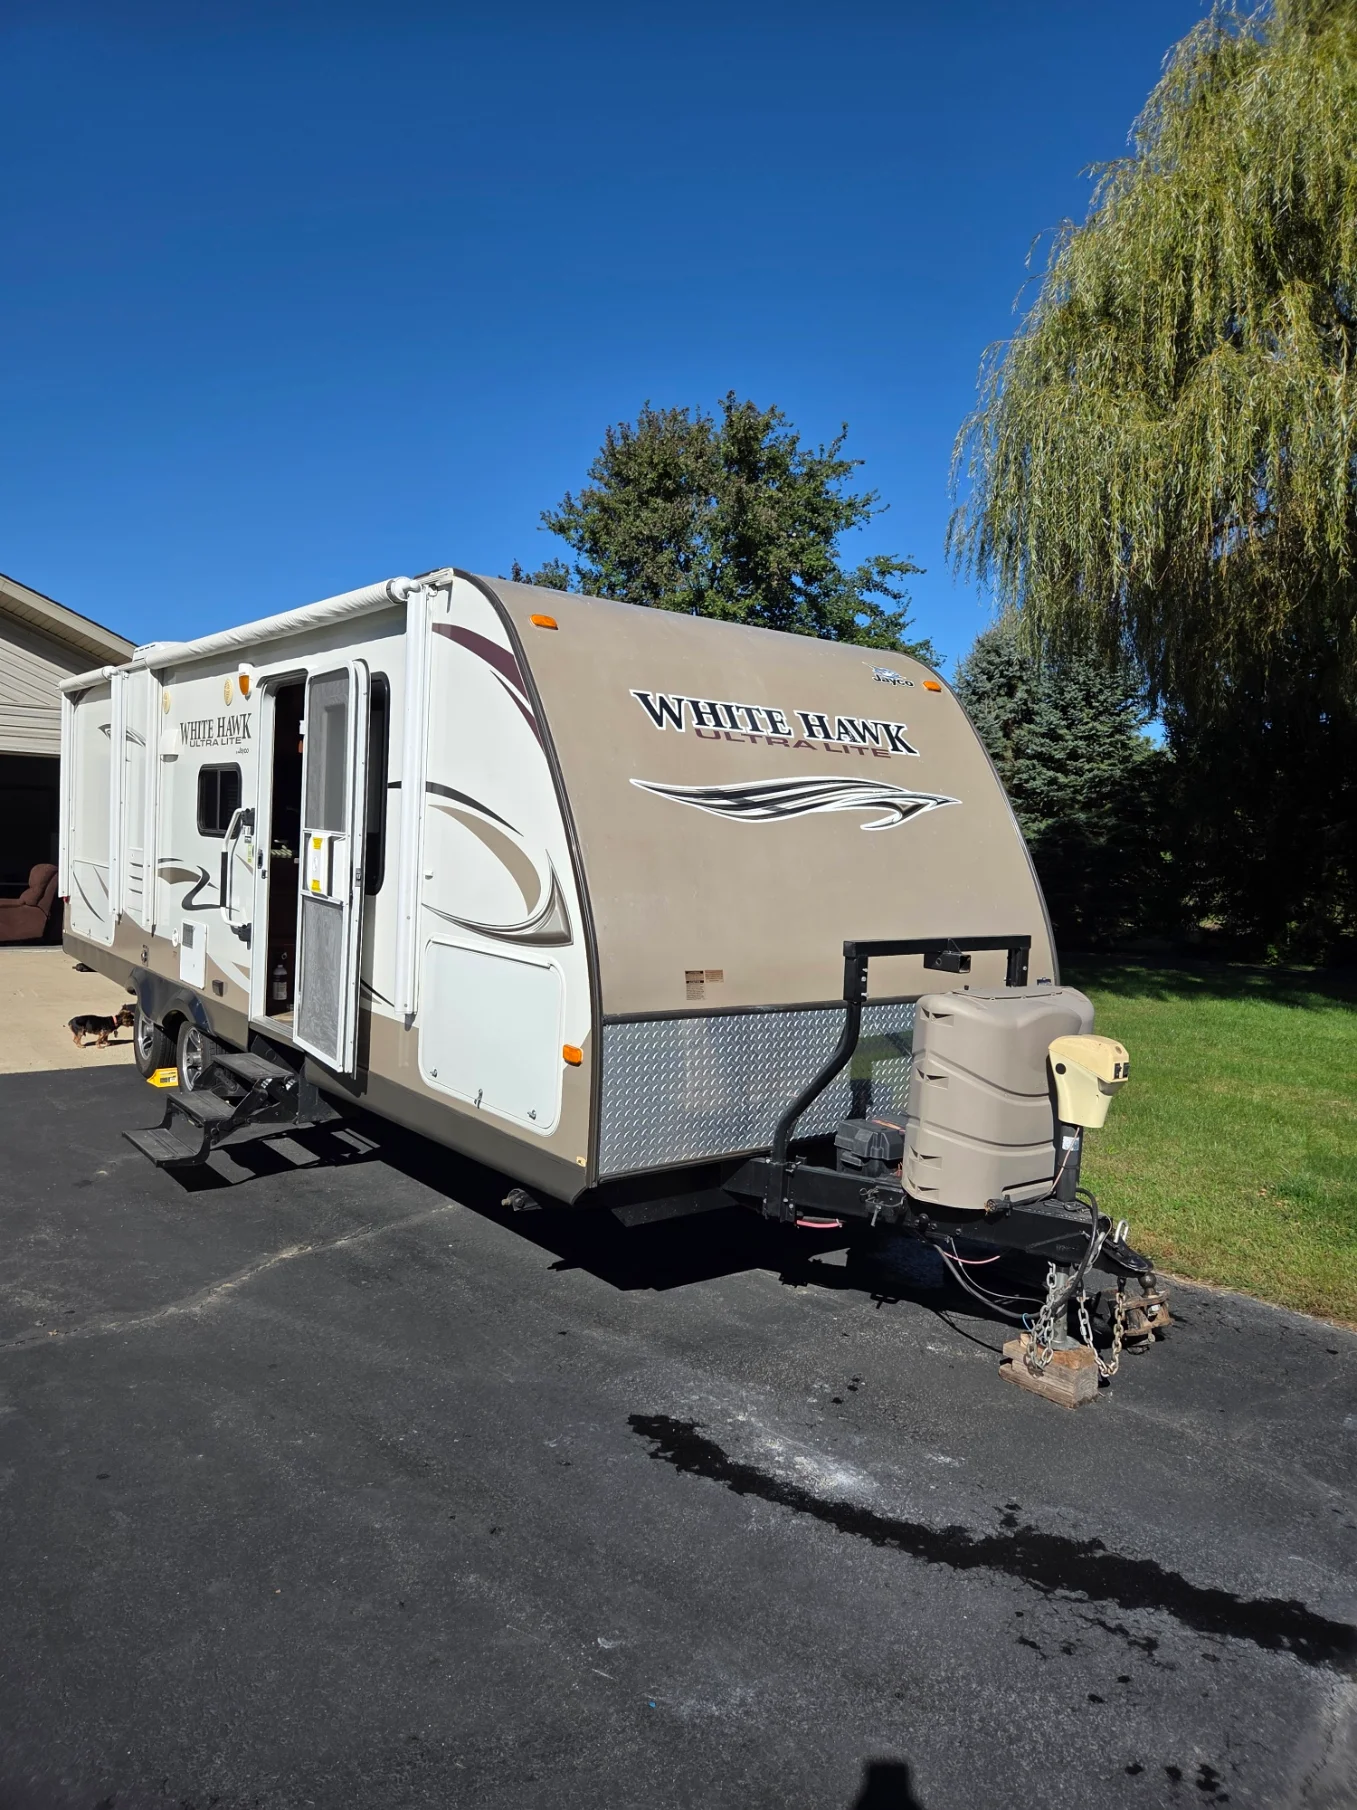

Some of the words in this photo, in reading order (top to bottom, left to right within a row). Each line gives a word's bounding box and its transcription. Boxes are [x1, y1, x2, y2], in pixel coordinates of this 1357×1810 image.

[873, 675, 914, 687] Jayco
[180, 719, 214, 745] WHITE
[217, 713, 252, 739] HAWK
[630, 690, 793, 737] WHITE
[795, 711, 920, 757] HAWK
[190, 739, 219, 747] ULTRA
[221, 737, 242, 745] LITE
[694, 728, 817, 751] ULTRA
[823, 742, 891, 759] LITE
